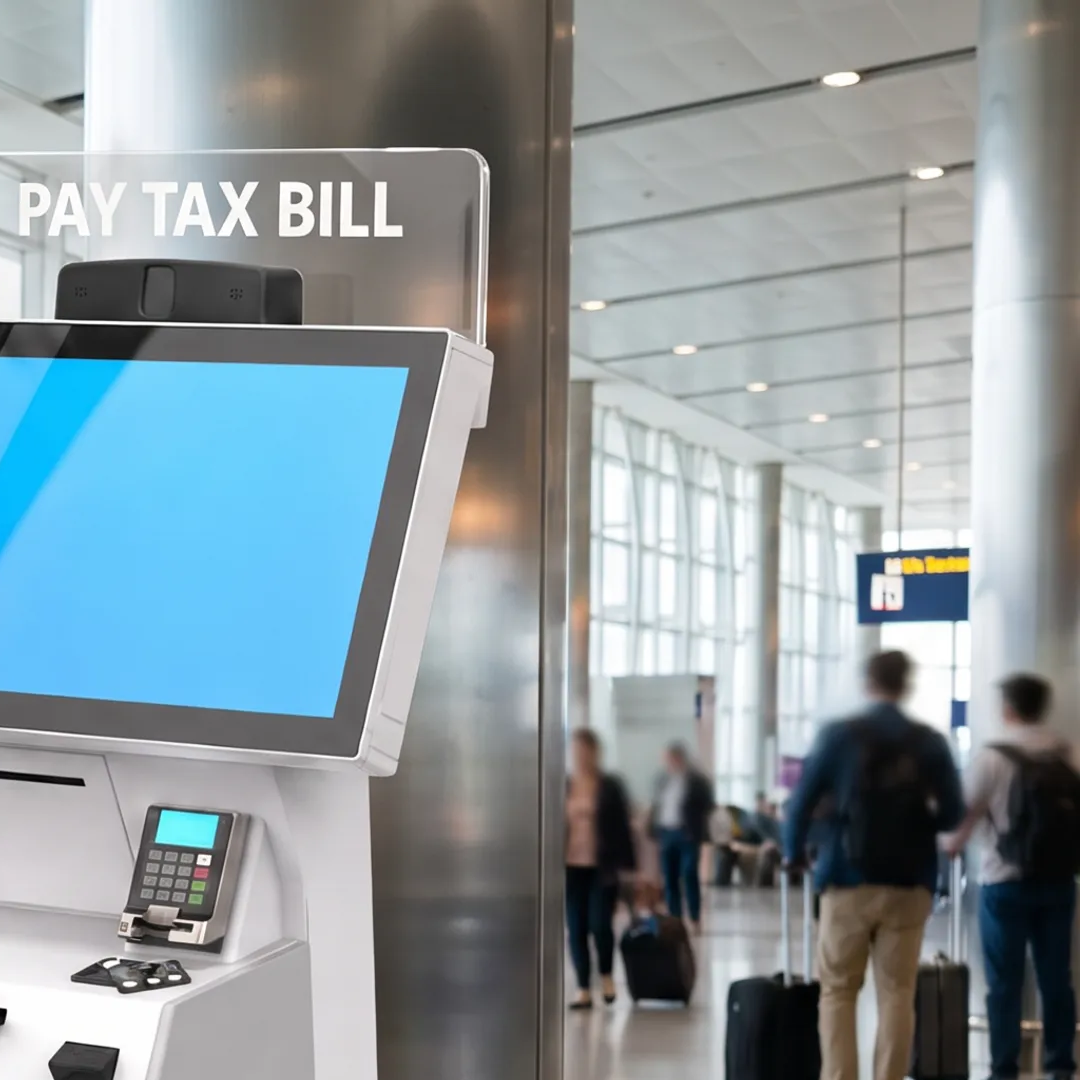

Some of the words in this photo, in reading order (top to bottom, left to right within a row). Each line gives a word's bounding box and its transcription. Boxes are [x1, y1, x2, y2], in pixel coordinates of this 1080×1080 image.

[19, 182, 127, 237] PAY
[142, 181, 259, 237] TAX
[278, 181, 403, 237] BILL
